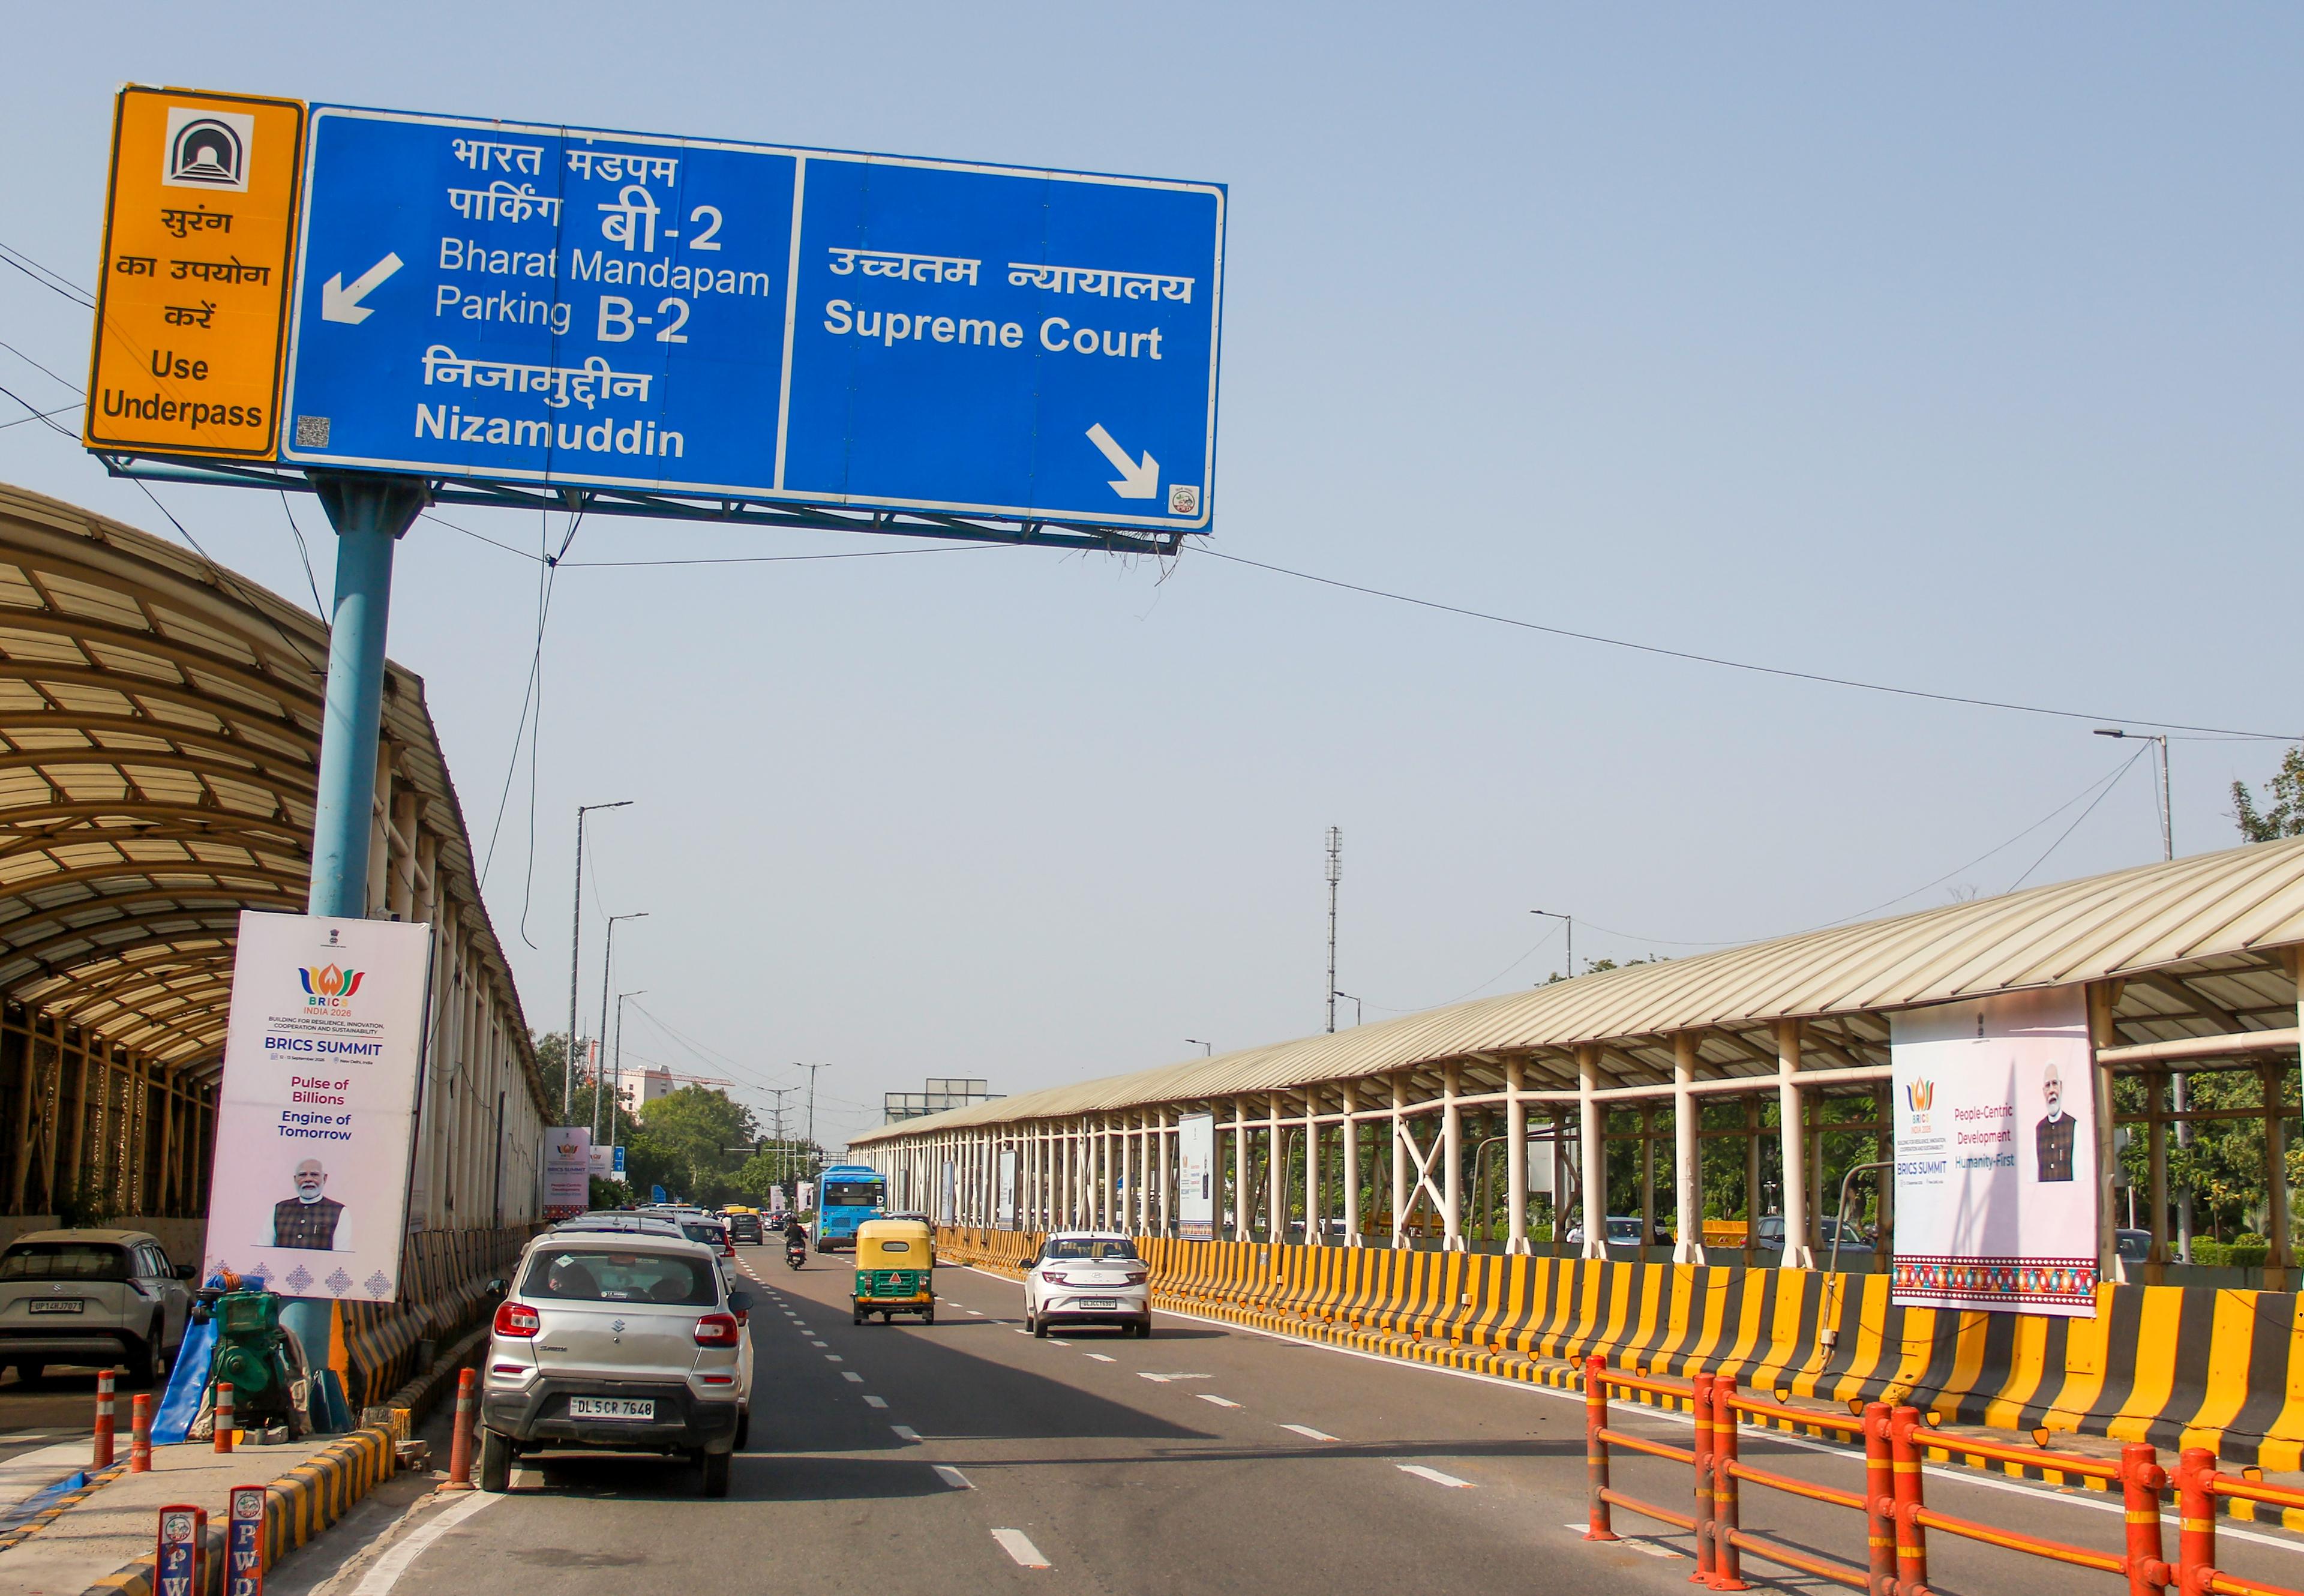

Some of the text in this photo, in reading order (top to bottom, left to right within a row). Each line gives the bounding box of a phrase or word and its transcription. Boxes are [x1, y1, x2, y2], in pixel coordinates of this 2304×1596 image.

[452, 139, 544, 176] भारत
[161, 204, 233, 238] सुरंग
[448, 181, 723, 253] पार्किंग बी-2
[116, 255, 271, 286] का उपयोग
[440, 238, 769, 299] Bharat Mandapam
[829, 247, 1195, 304] उच्चतम न्यायालय
[165, 300, 217, 329] करें
[436, 285, 690, 344] Parking B-2
[823, 299, 1162, 361] Supreme Court
[152, 350, 209, 380] Use
[422, 345, 653, 410] निजामुद्दीन
[104, 389, 262, 430] Underpass
[415, 403, 685, 458] Nizamuddin
[304, 1007, 352, 1017] INDIA 2026
[309, 997, 349, 1007] BRICS
[265, 1037, 383, 1056] BRICS SUMMIT
[291, 1076, 349, 1091] Pulse of
[292, 1092, 344, 1105] Billions
[283, 1111, 352, 1125] Engine of
[1912, 1114, 1929, 1124] BRICS
[1954, 1103, 2012, 1123] People-Centric
[278, 1126, 352, 1141] Tomorrow
[1957, 1129, 2011, 1146] Development
[1897, 1161, 1947, 1175] BRICS SUMMIT
[1955, 1153, 2014, 1171] Humanity-First
[623, 1402, 652, 1416] 7648
